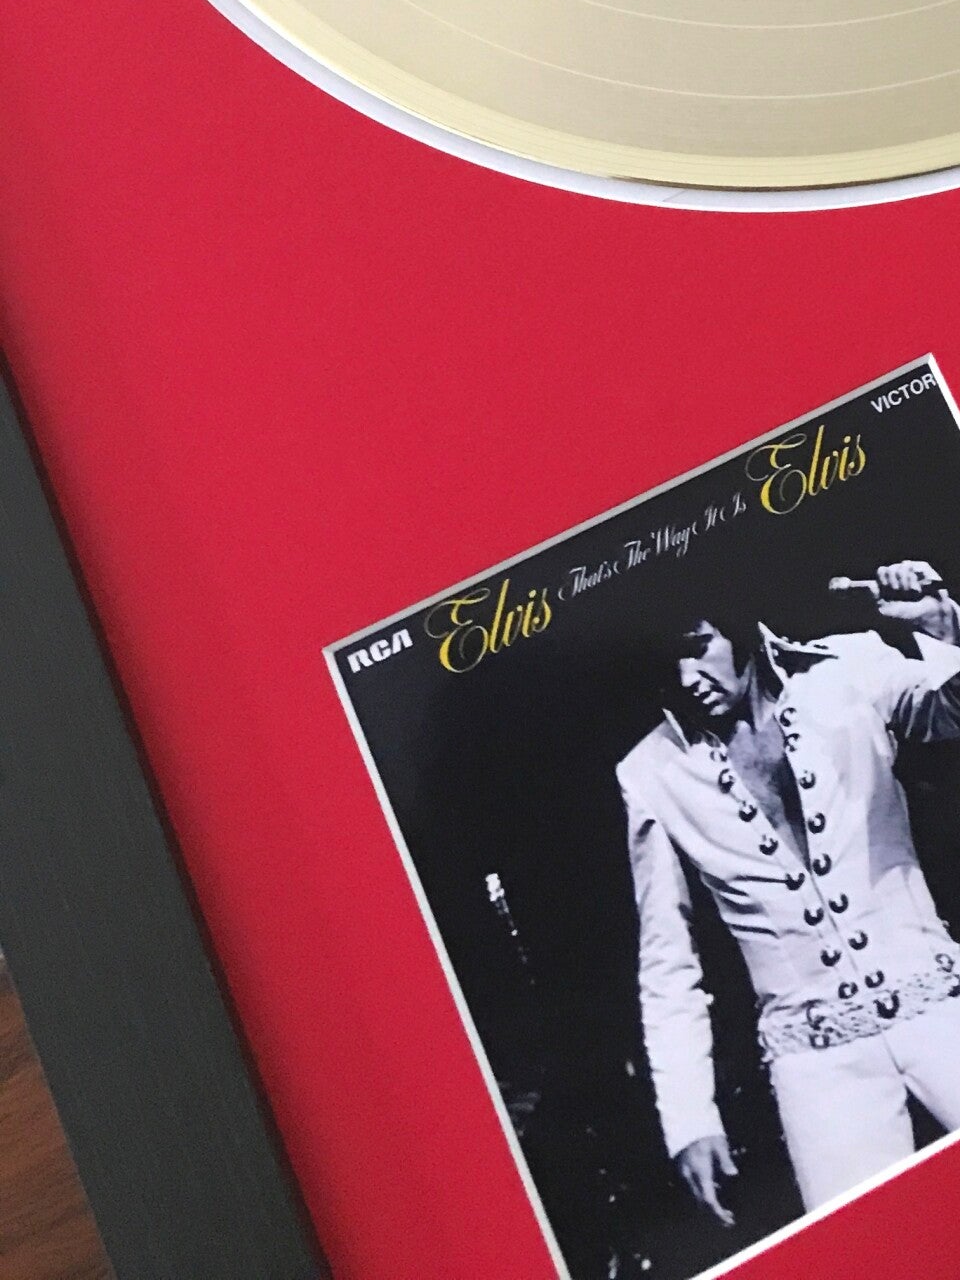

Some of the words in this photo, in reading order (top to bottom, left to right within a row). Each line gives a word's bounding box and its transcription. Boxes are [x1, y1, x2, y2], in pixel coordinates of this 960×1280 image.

[871, 372, 936, 413] VICTOR
[423, 578, 551, 673] Elvis
[624, 540, 651, 570] The
[652, 523, 697, 558] Way
[746, 424, 866, 515] Elvis
[347, 628, 413, 674] RCA
